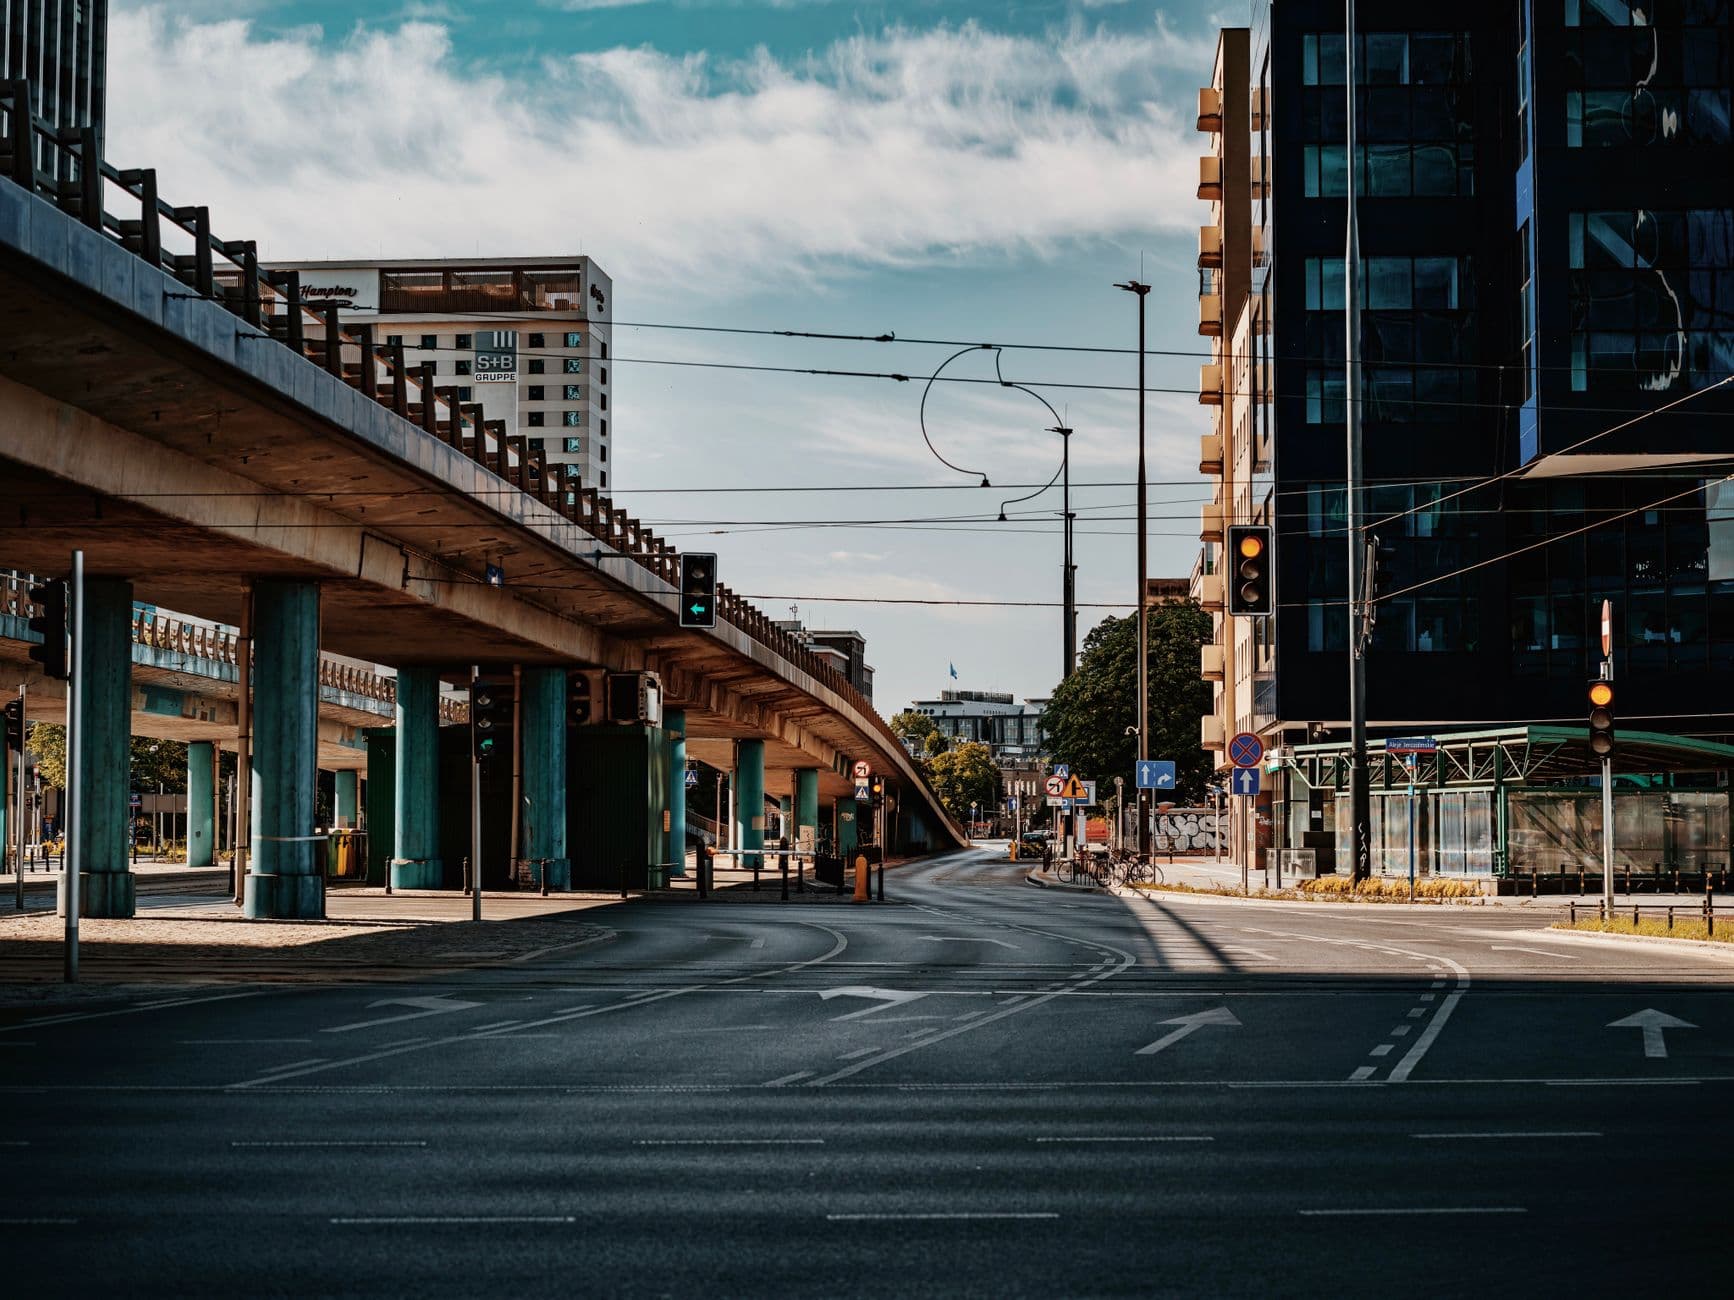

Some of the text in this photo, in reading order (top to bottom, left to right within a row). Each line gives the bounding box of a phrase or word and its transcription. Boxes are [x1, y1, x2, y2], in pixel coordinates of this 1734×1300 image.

[300, 285, 357, 298] Hampton
[477, 355, 513, 369] S+B
[475, 373, 516, 381] GRUPPE
